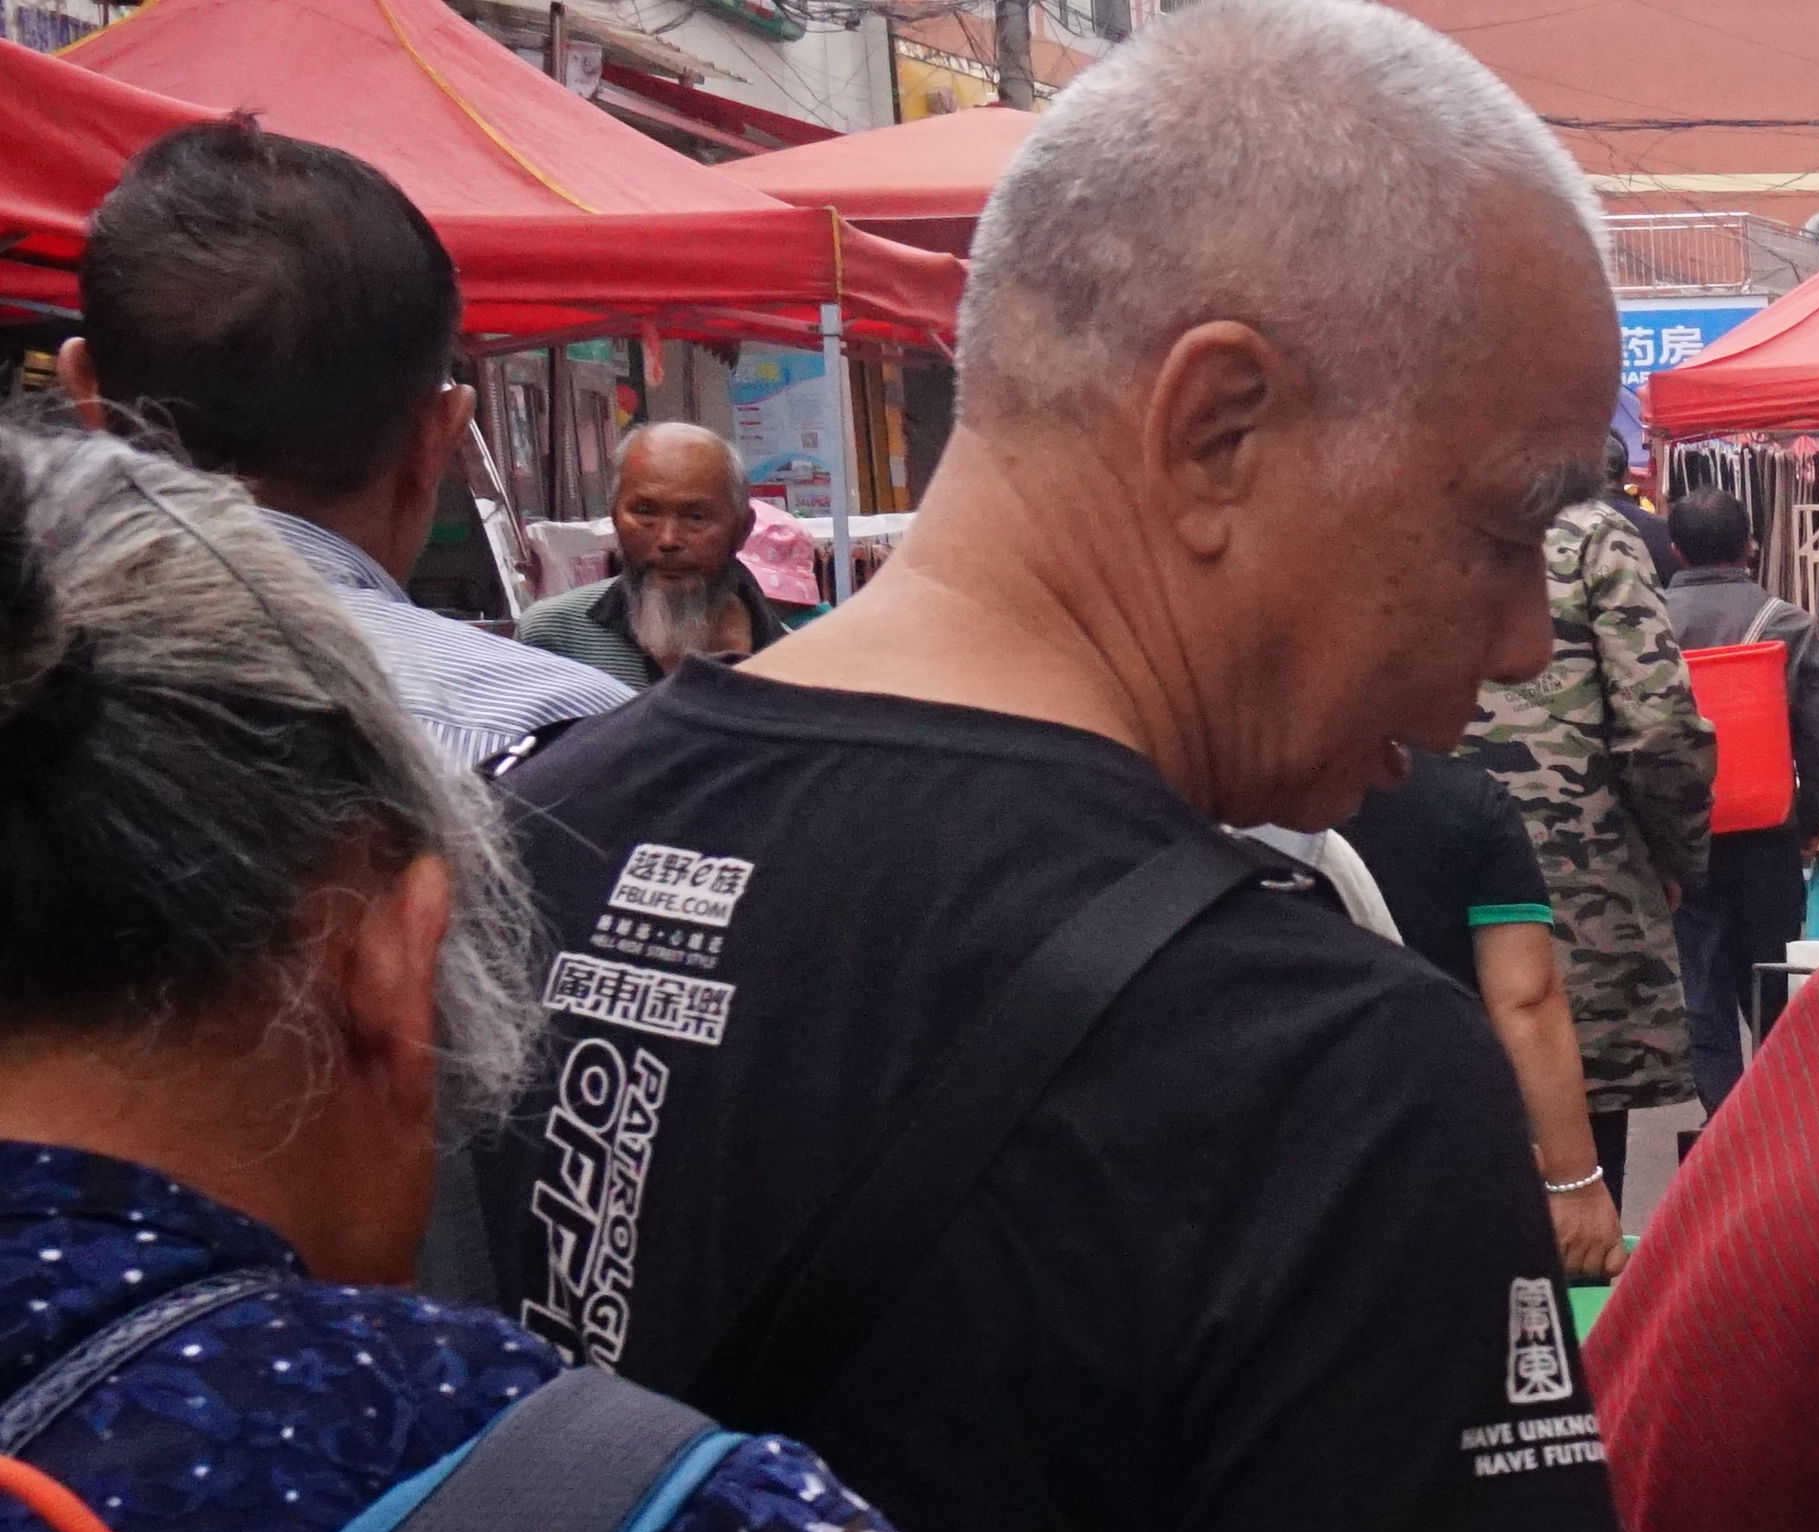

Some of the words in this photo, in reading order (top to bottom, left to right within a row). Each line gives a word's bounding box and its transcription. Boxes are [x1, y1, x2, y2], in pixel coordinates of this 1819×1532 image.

[626, 849, 748, 896] 越野e族
[614, 884, 729, 919] FBLIFE.COM
[1461, 1424, 1514, 1450] HAVE
[1474, 1447, 1539, 1478] HAVE
